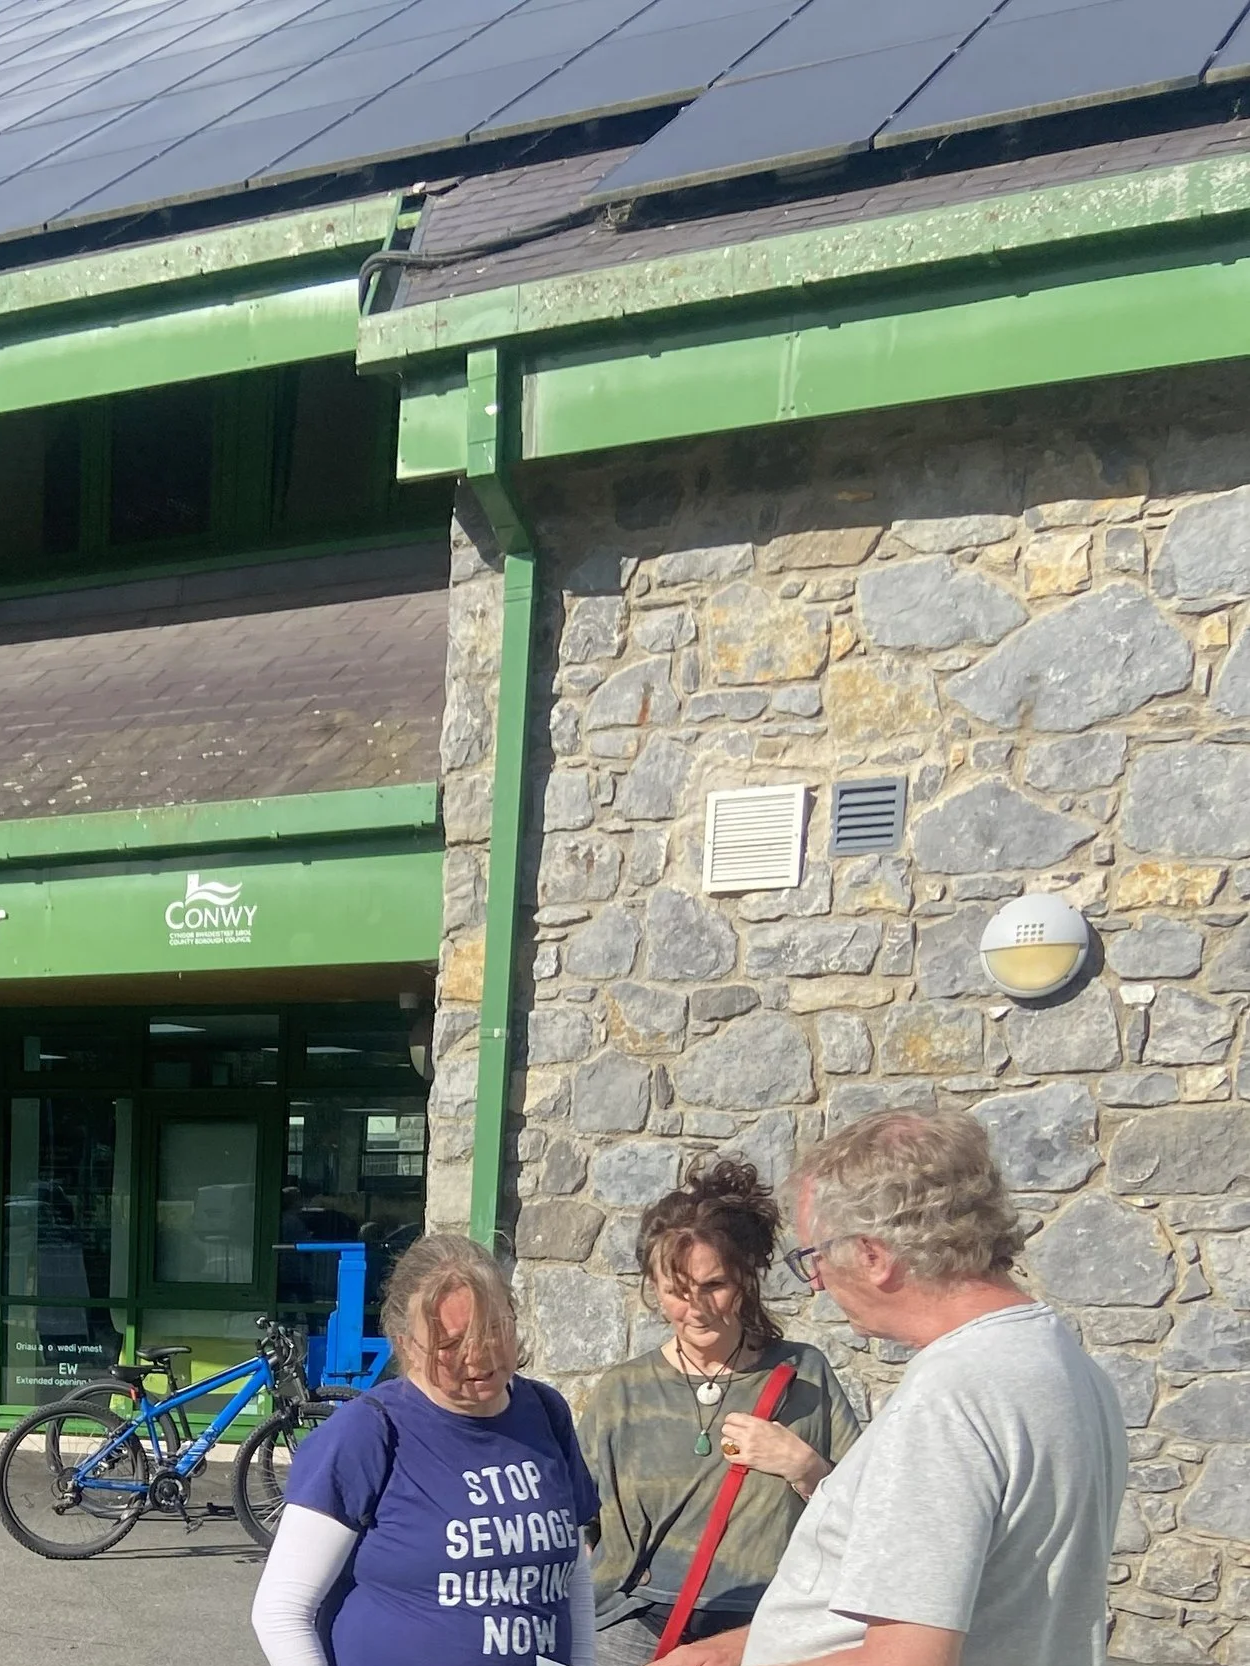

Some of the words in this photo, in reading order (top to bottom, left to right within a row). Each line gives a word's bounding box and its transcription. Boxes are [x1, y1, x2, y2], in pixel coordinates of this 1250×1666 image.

[16, 1376, 54, 1385] Extended
[462, 1460, 542, 1506] STOP
[446, 1508, 578, 1560] SEWAGE
[482, 1614, 558, 1656] NOW
